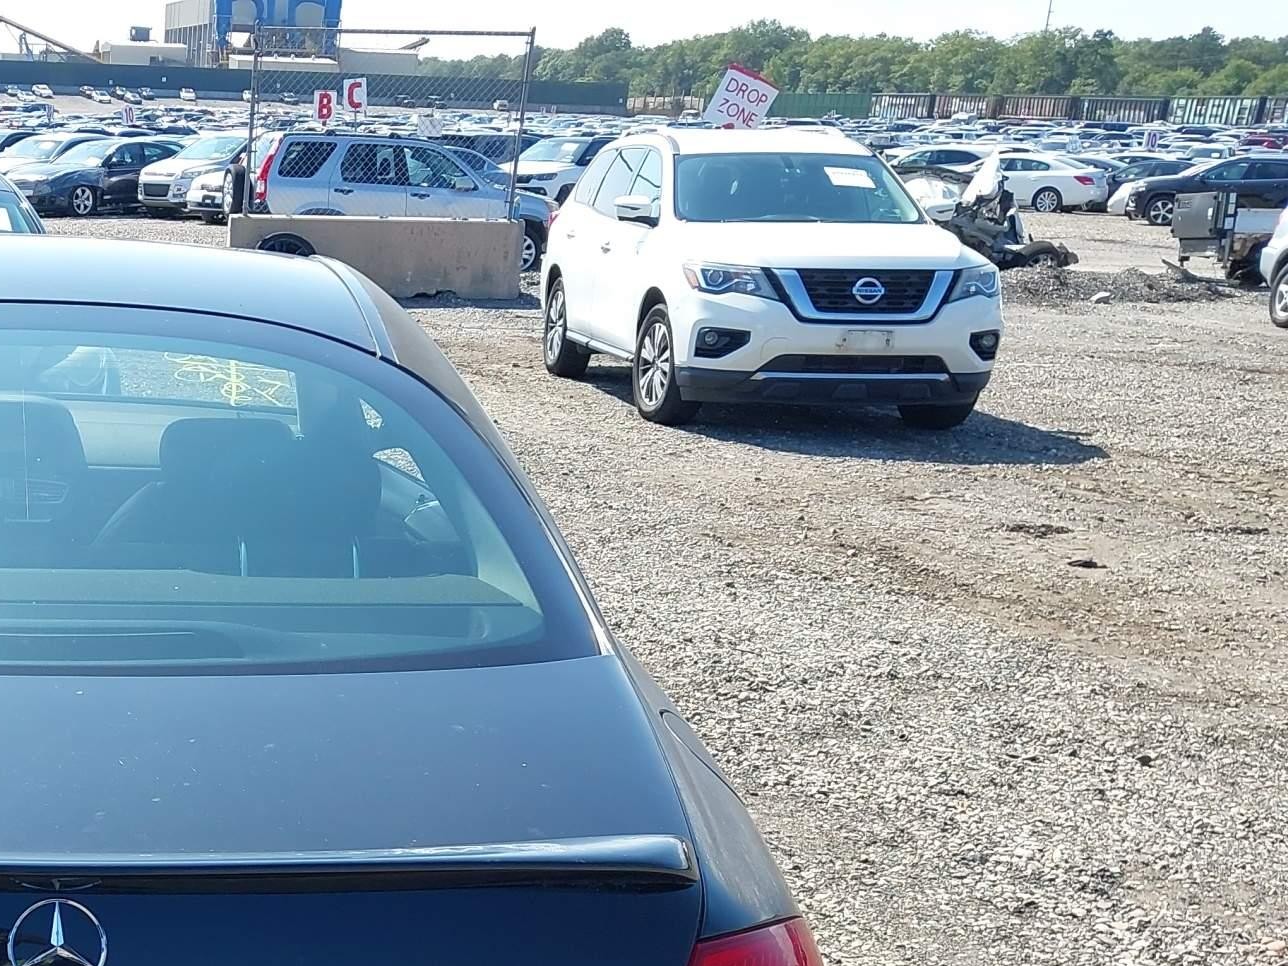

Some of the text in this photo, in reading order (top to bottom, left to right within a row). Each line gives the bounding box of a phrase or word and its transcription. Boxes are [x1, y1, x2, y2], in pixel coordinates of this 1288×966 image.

[318, 92, 332, 119] B
[347, 81, 362, 108] C
[725, 77, 768, 107] DROP
[124, 107, 135, 123] 10
[717, 98, 758, 128] ZONE
